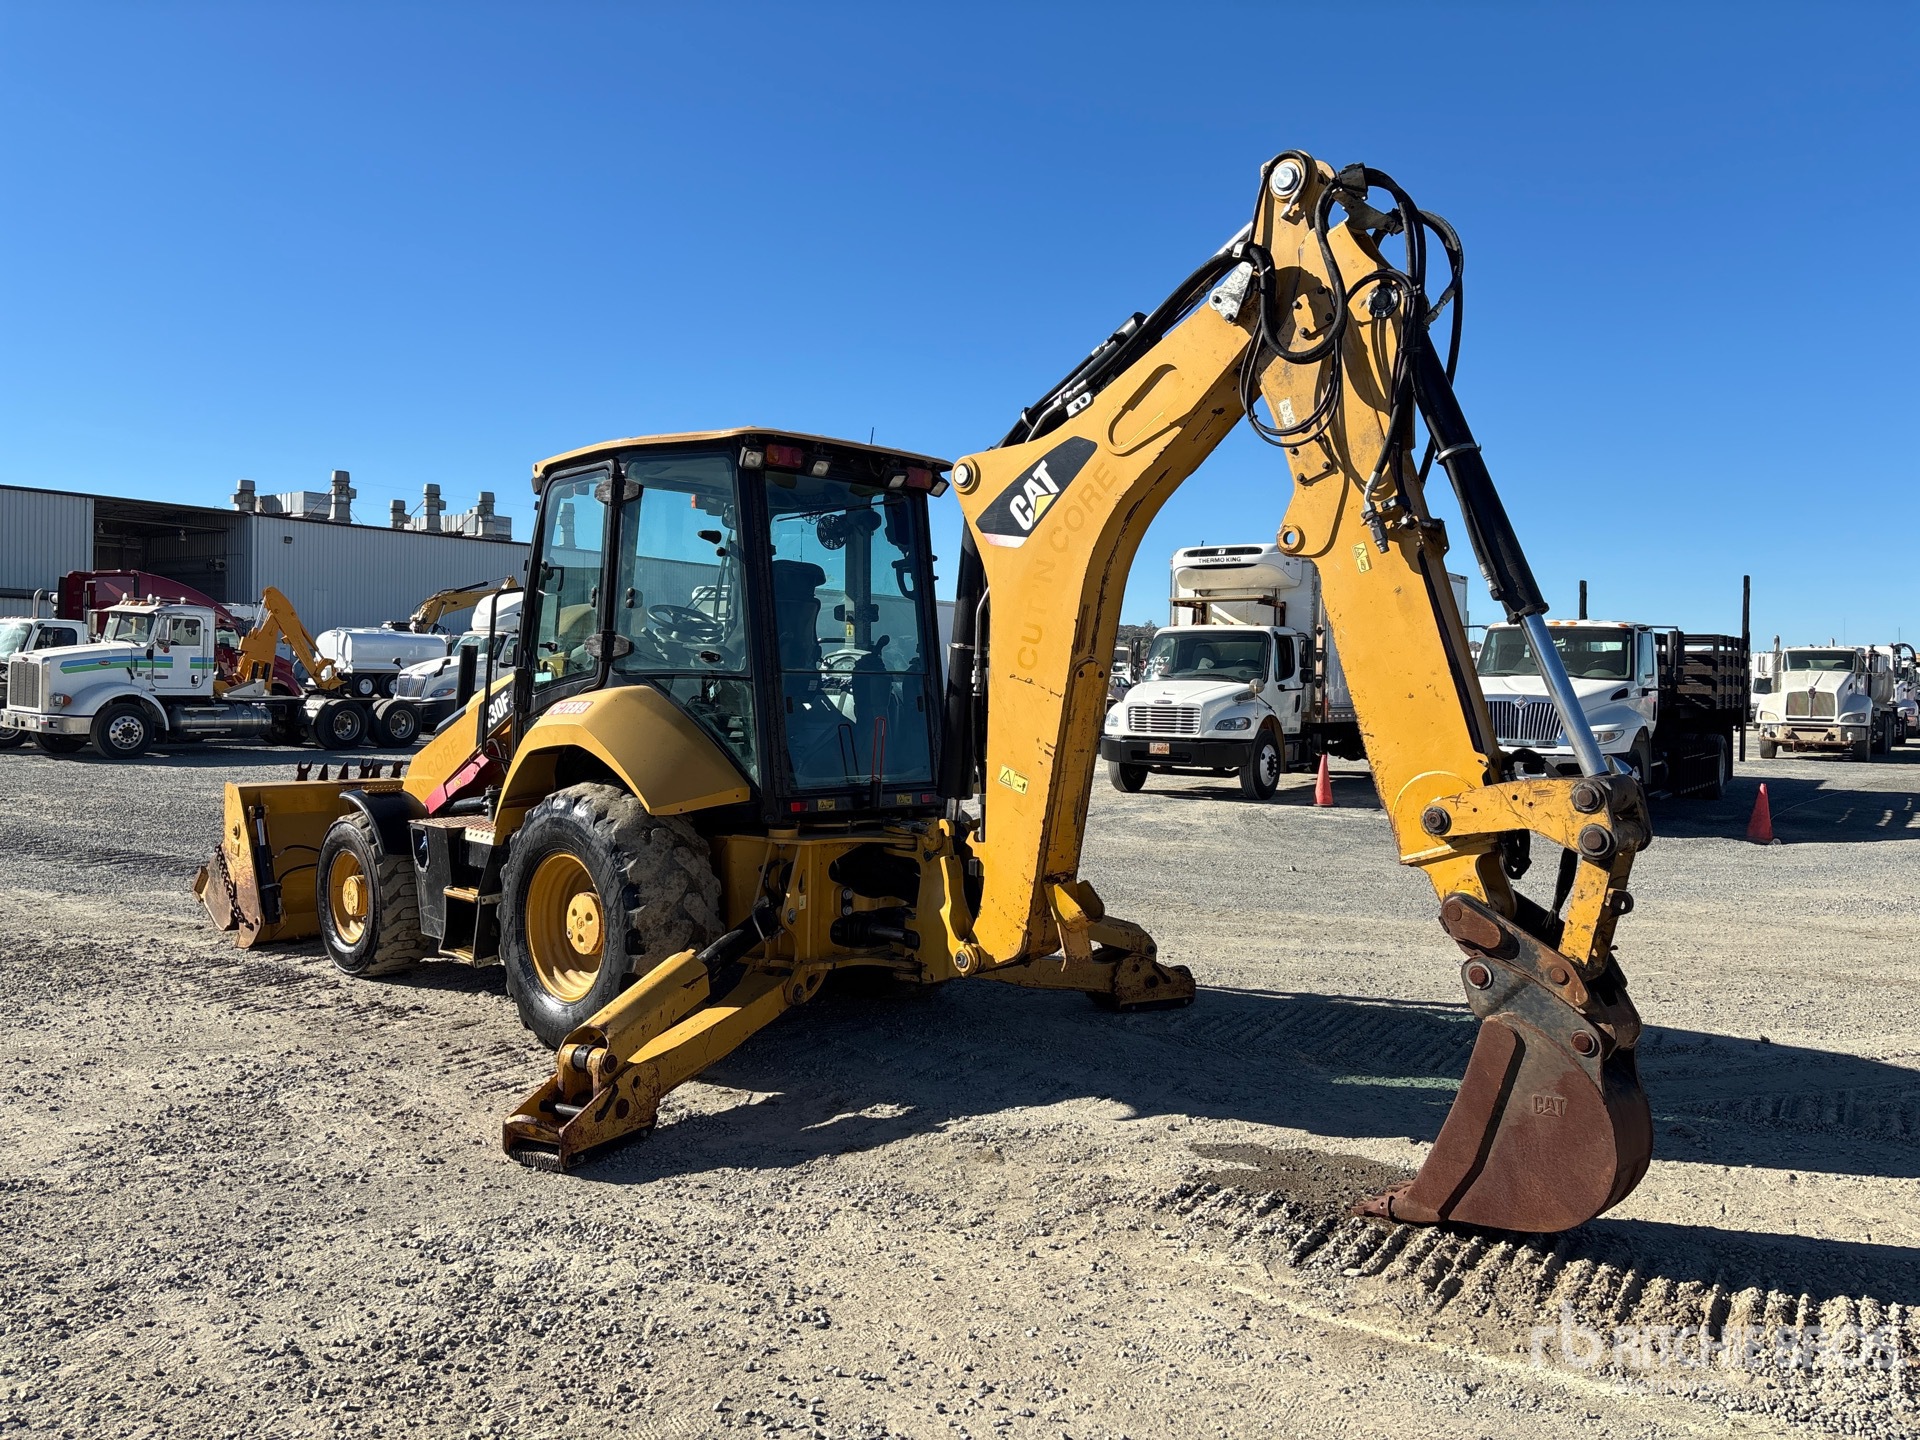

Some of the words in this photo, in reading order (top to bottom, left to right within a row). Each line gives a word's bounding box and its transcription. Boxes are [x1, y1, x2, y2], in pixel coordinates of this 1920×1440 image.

[1009, 460, 1060, 531] CAT
[1048, 462, 1118, 554] CORE
[1531, 1093, 1568, 1118] CAT
